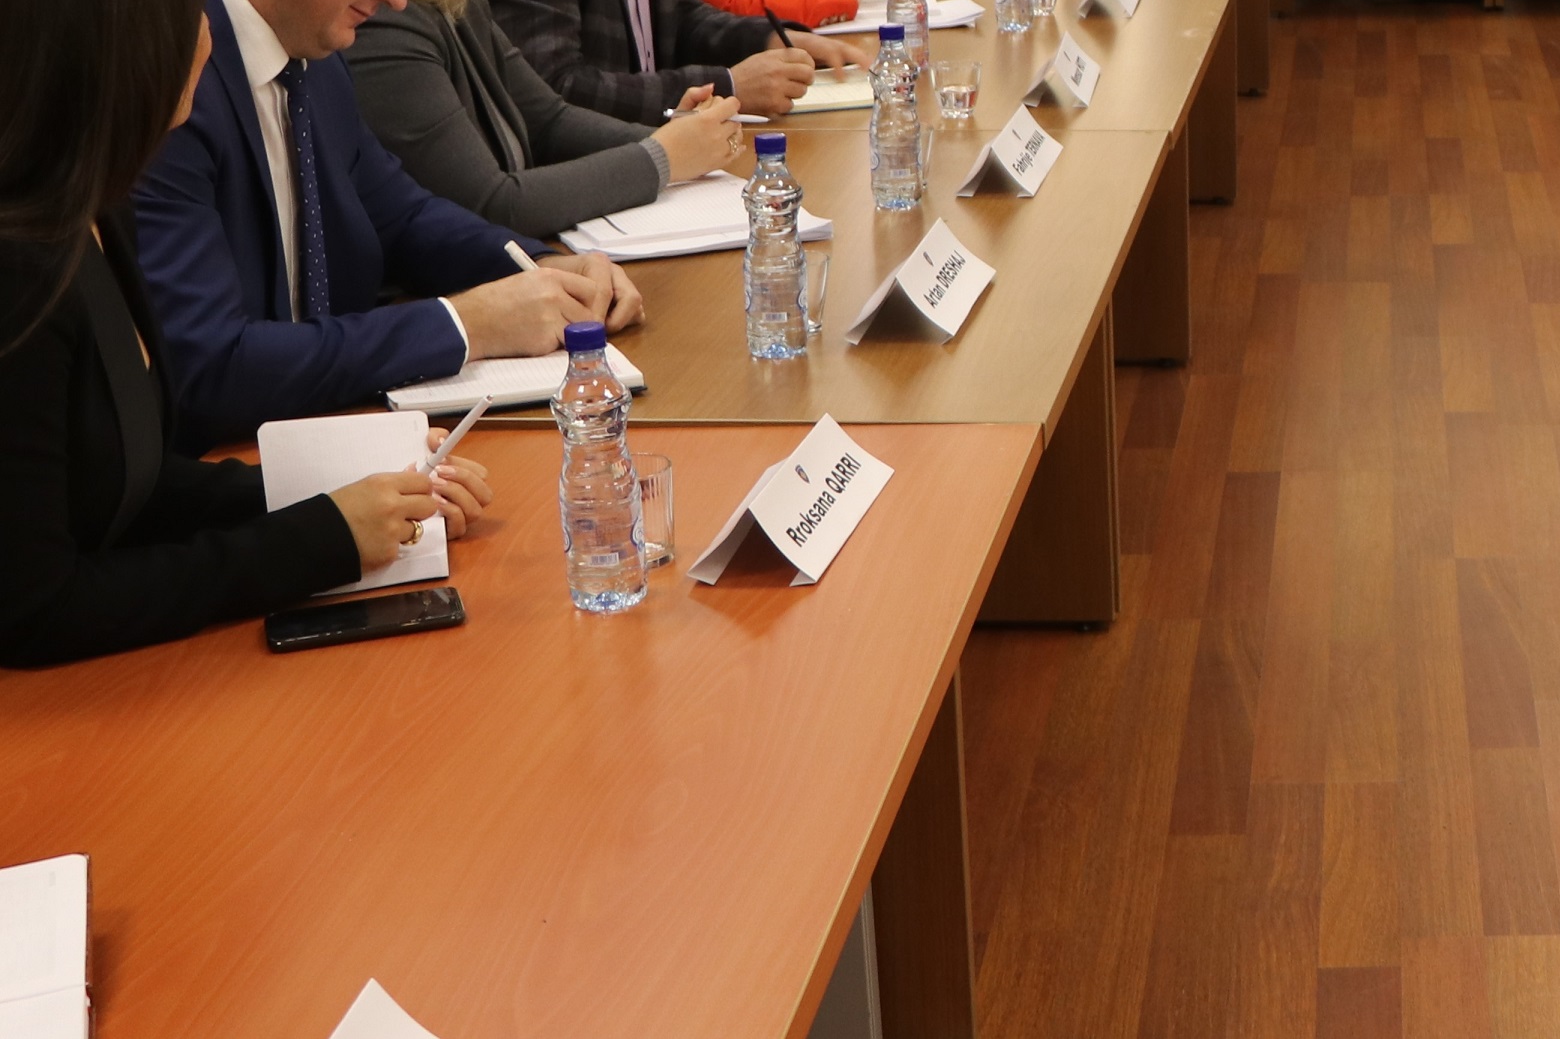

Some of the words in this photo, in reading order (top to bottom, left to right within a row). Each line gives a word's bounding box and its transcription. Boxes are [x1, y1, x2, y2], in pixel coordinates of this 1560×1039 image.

[923, 283, 947, 309] Artan
[935, 249, 966, 289] DRESHAJ
[785, 490, 837, 548] Rroksana
[825, 452, 862, 494] QARRI
